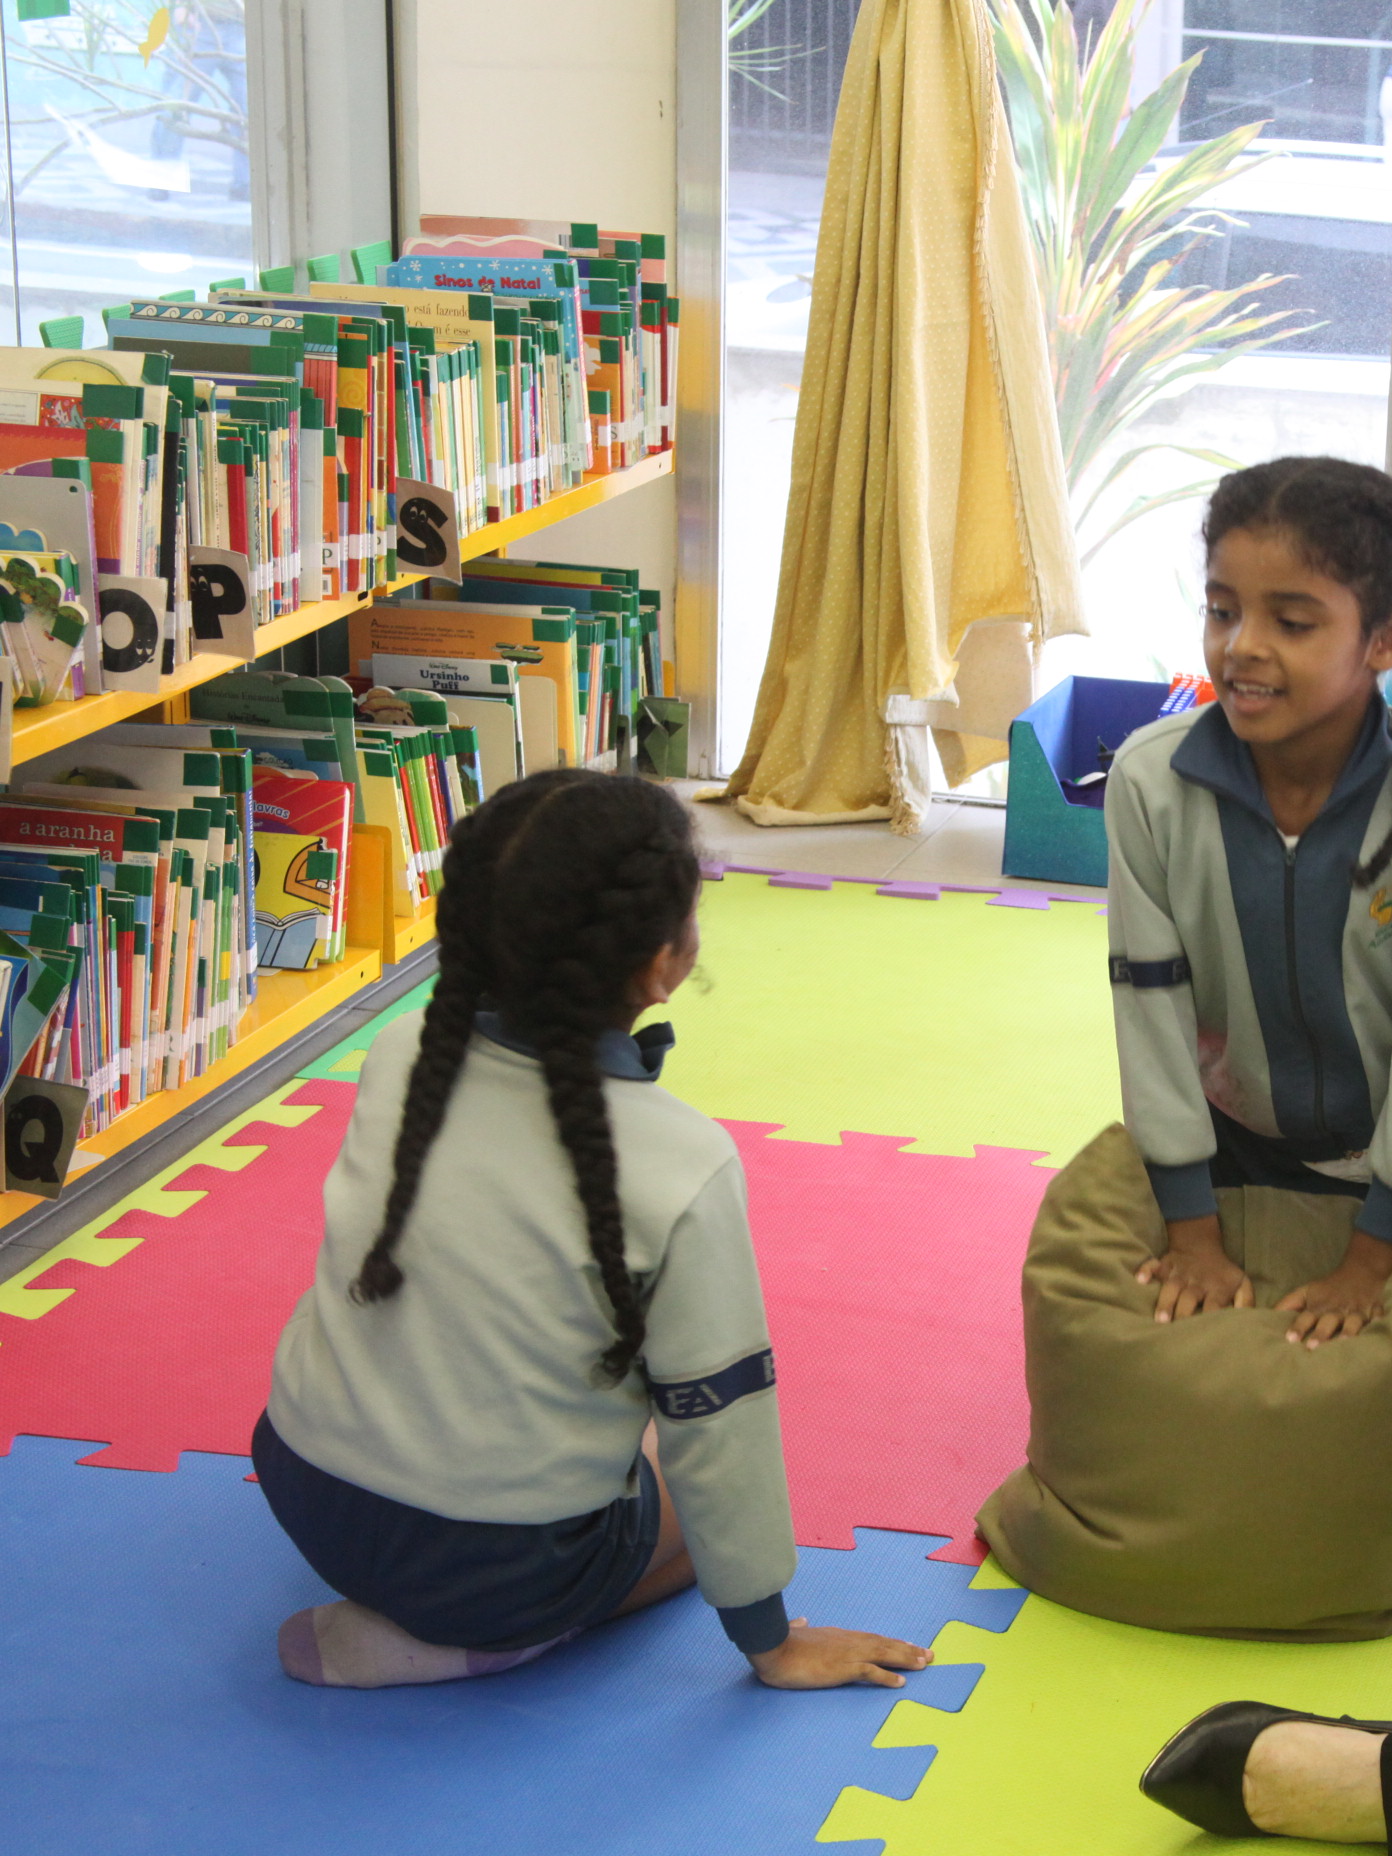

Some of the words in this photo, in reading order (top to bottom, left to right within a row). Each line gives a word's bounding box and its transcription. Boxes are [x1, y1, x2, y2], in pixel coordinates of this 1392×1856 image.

[433, 274, 473, 288] Sinos
[500, 277, 542, 290] Natal
[397, 496, 449, 568] S
[322, 548, 333, 566] P
[191, 564, 247, 640] P
[98, 588, 159, 673] O
[419, 669, 470, 682] Ursinho
[431, 680, 460, 691] Puff
[252, 800, 290, 819] lavras
[20, 821, 31, 835] a
[35, 823, 116, 842] aranha
[5, 1094, 64, 1184] Q
